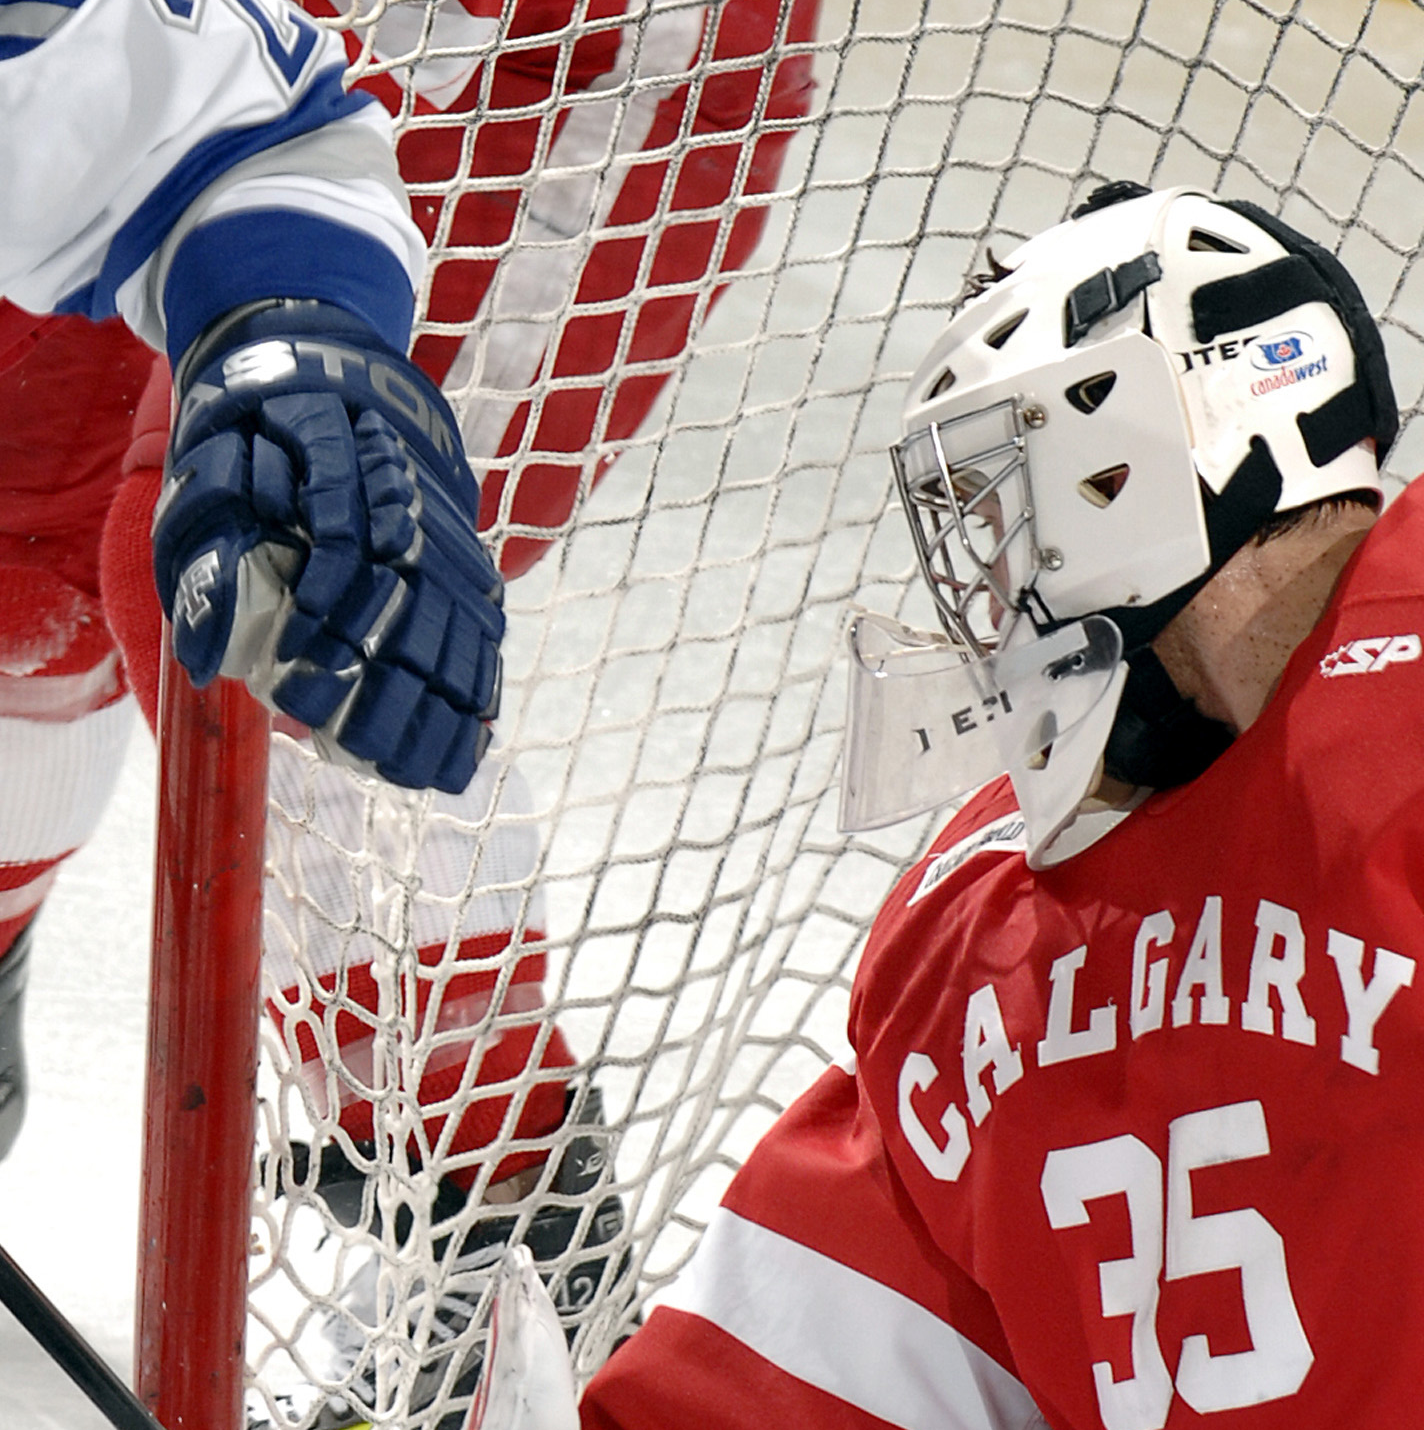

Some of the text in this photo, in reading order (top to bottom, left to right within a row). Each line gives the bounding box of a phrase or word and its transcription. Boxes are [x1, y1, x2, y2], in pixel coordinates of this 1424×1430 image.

[1175, 334, 1262, 374] ITE
[1250, 354, 1328, 397] canadawest
[897, 894, 1417, 1183] CALGARY
